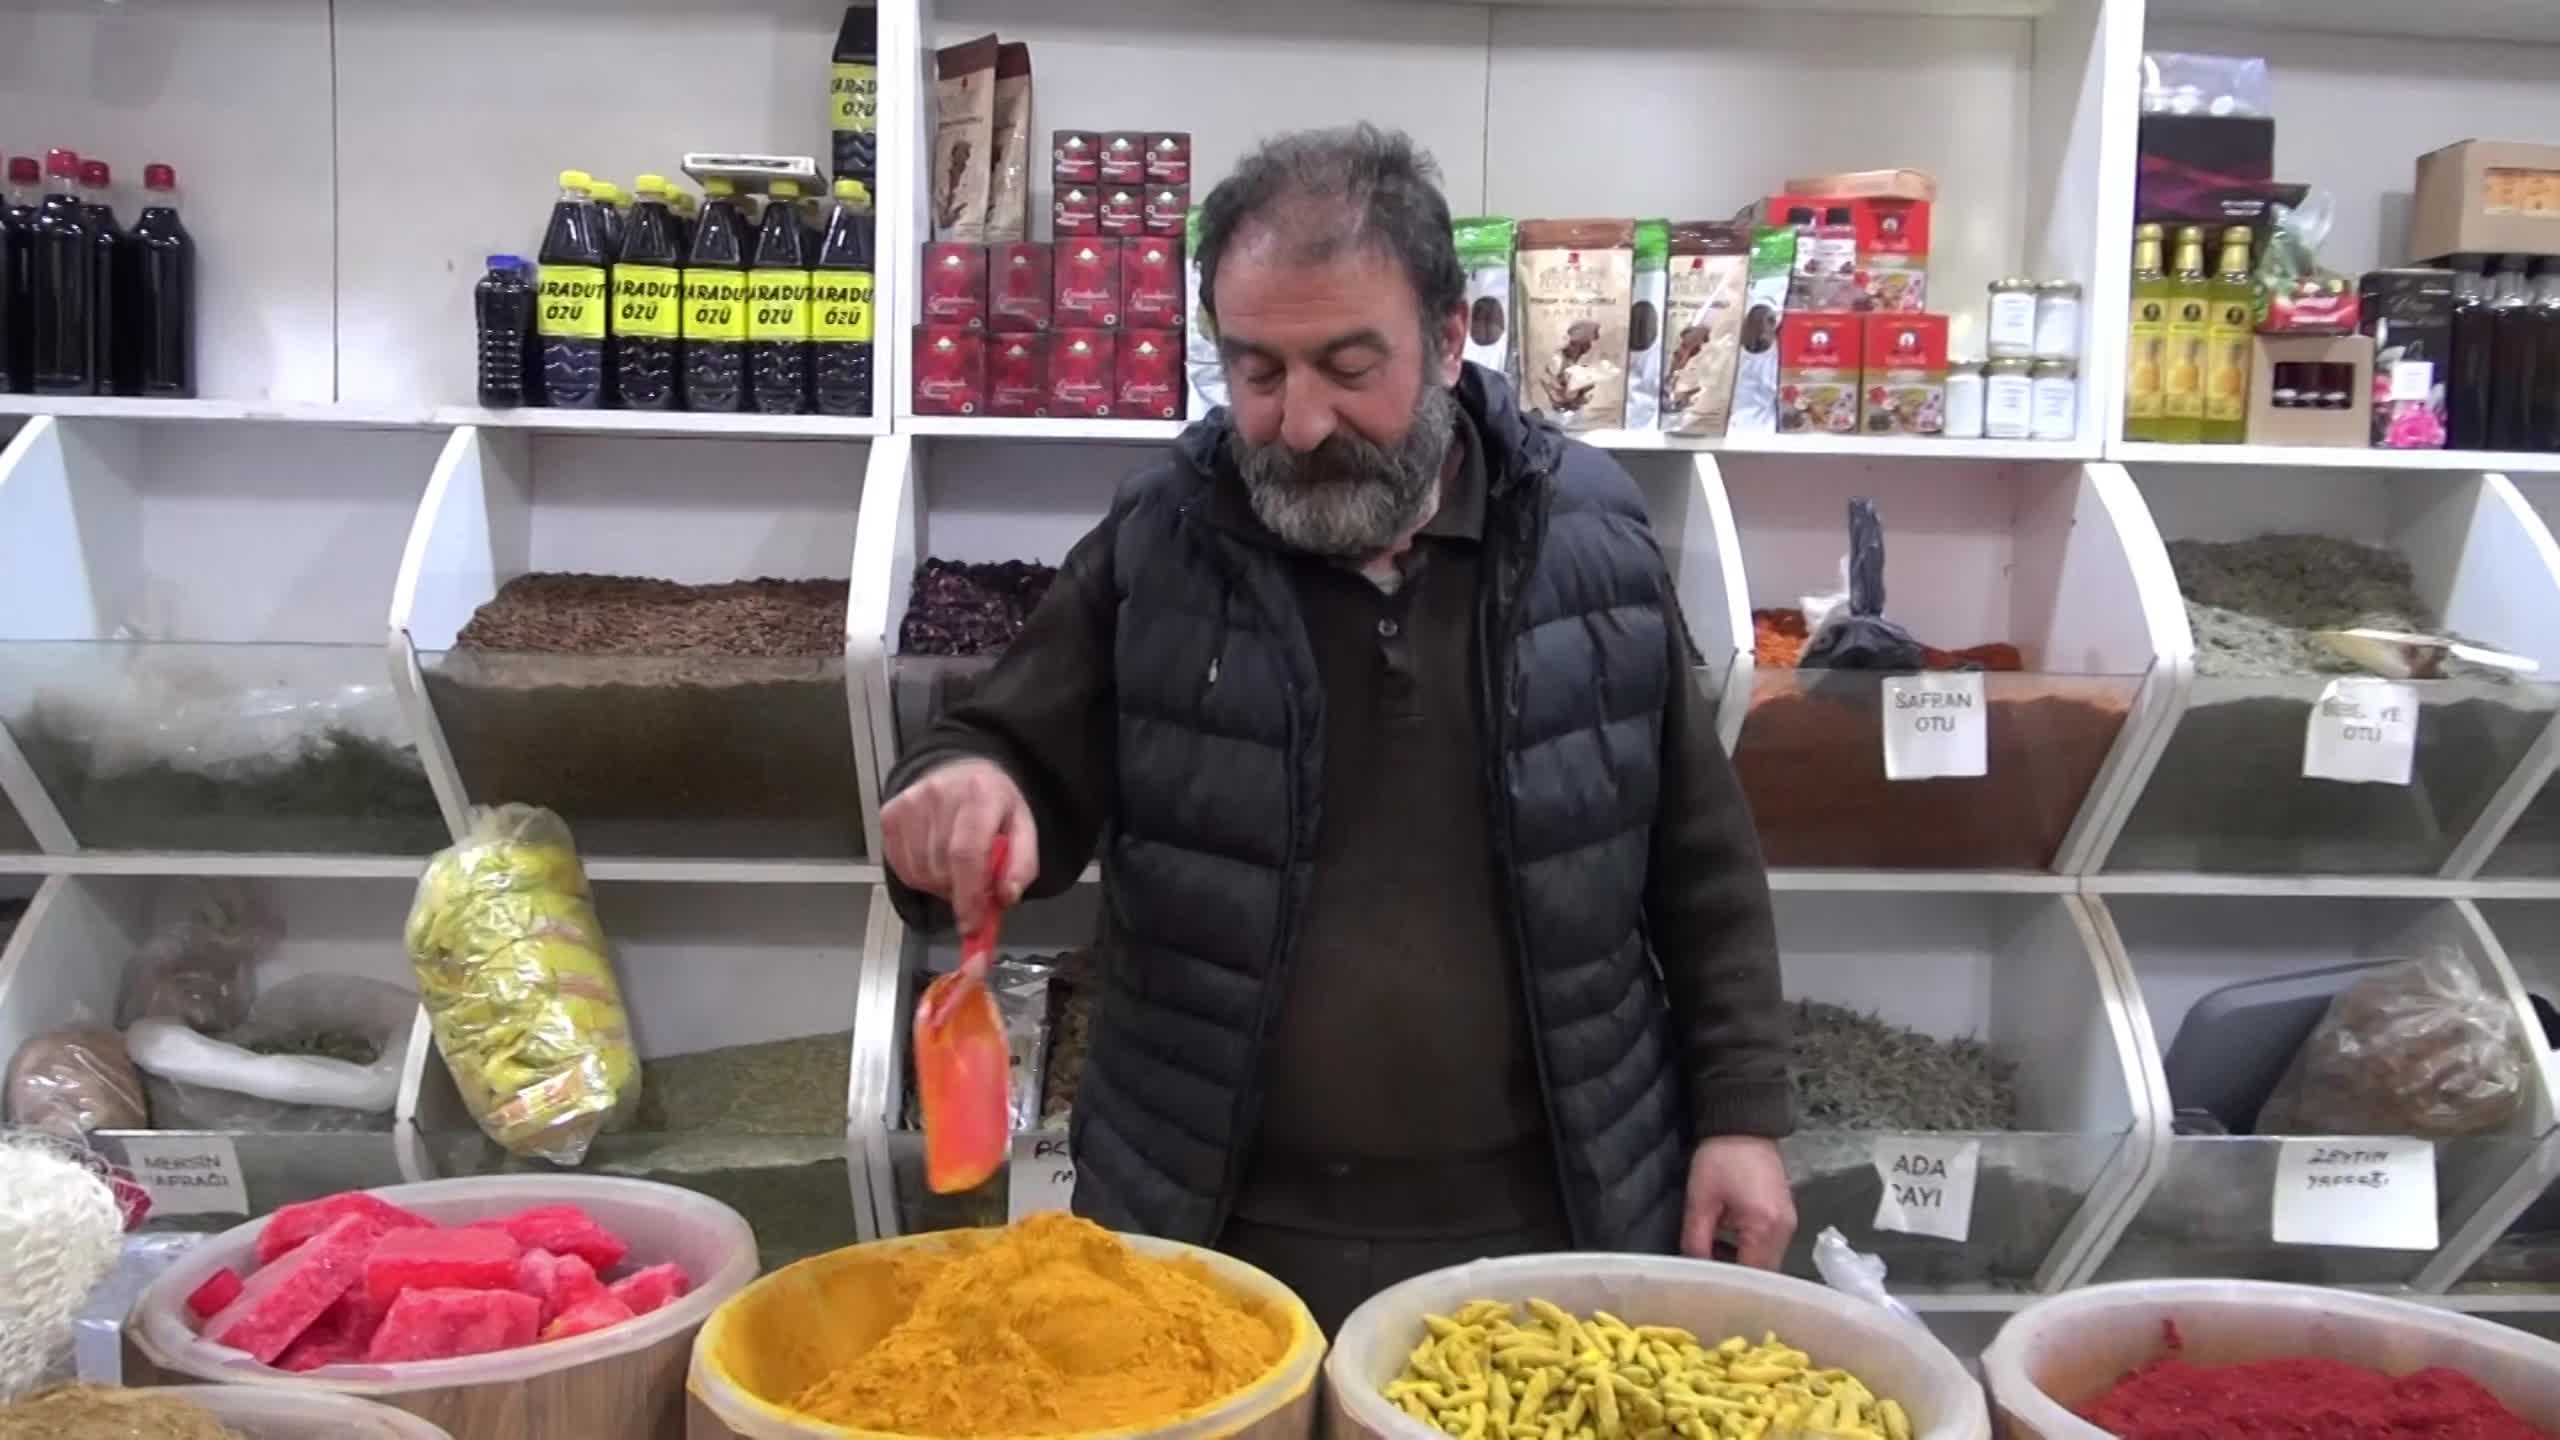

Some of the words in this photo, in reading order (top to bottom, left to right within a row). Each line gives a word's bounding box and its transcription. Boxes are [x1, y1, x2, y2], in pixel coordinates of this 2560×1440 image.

[1895, 691, 1972, 709] SAFRAN
[1915, 715, 1955, 733] OTU
[1893, 1154, 1947, 1178] ADA
